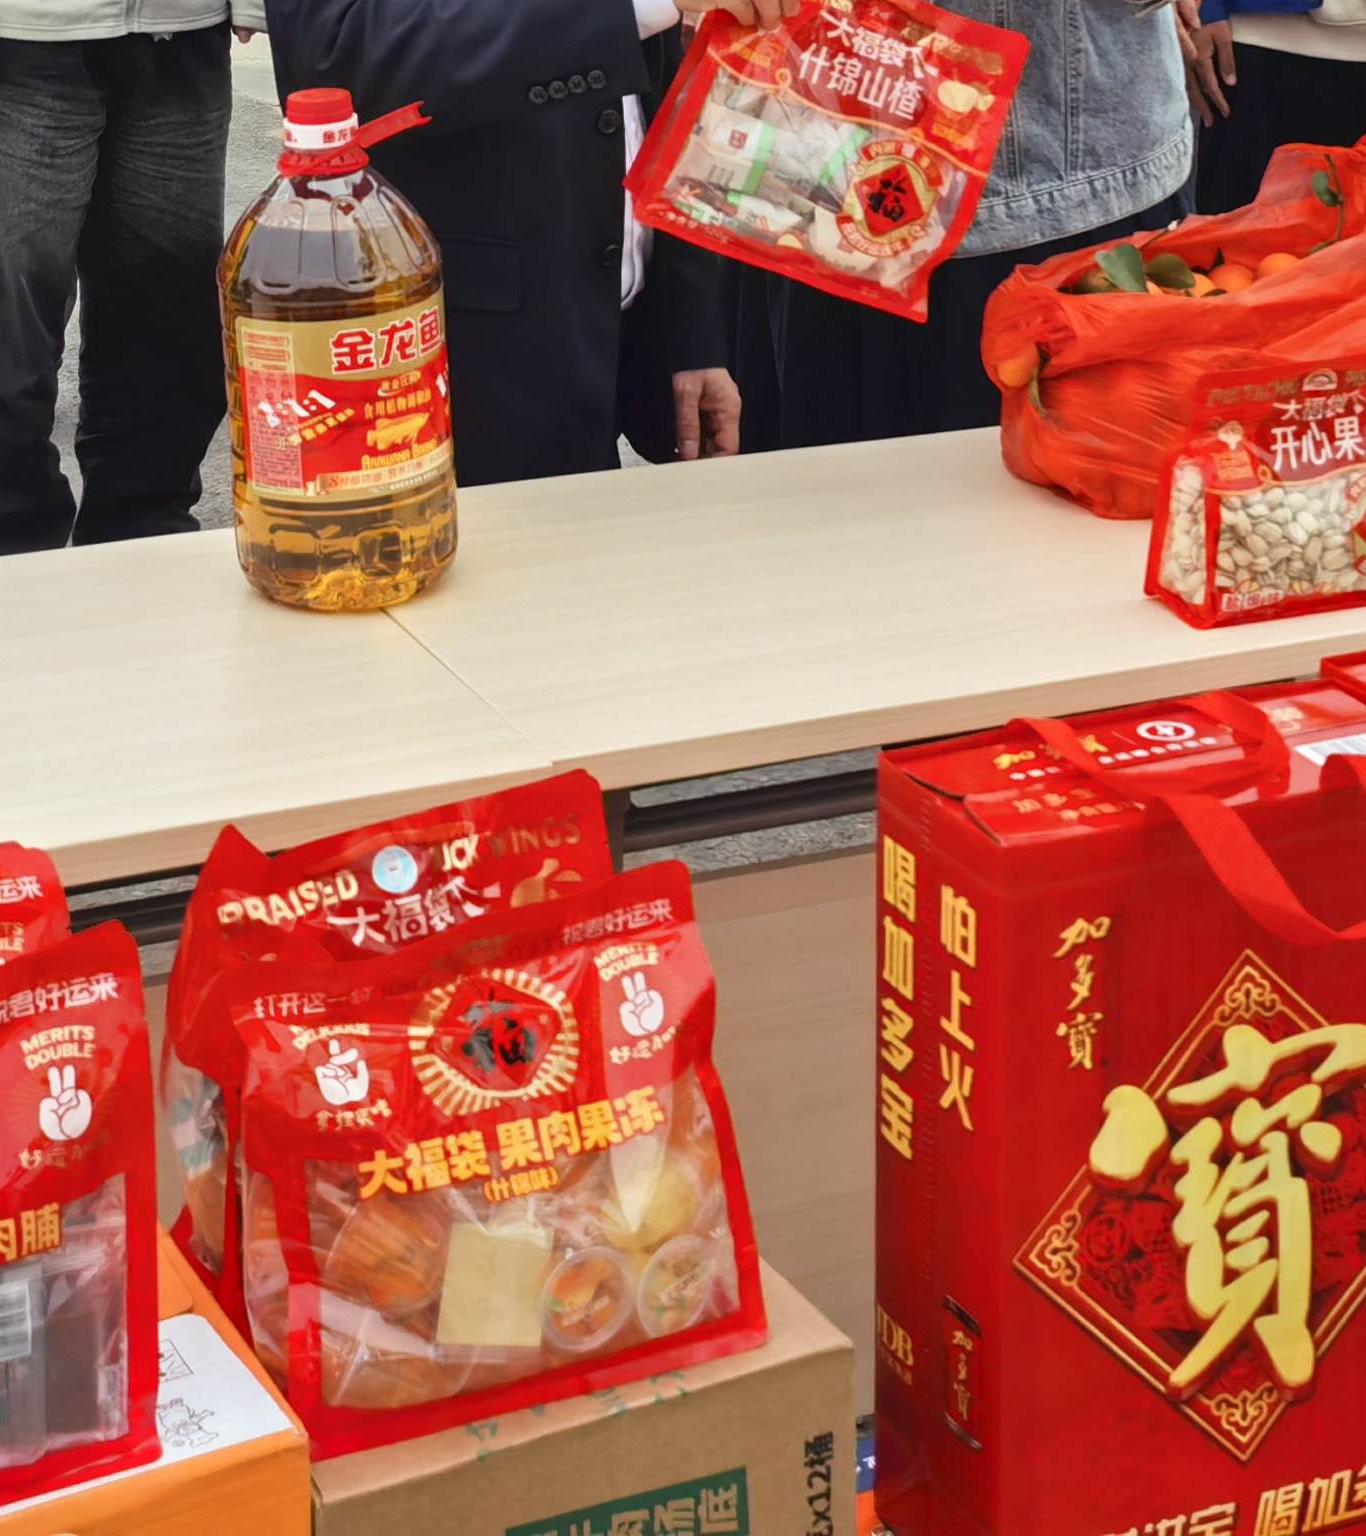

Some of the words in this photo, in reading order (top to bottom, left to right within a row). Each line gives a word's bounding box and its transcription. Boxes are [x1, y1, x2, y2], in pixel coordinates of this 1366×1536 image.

[798, 43, 923, 120] 什锦山楂
[330, 308, 441, 374] 金龙鱼
[1271, 416, 1365, 472] 开心果
[326, 874, 501, 948] 大福袋
[562, 898, 673, 945] 祝君好运来
[599, 951, 659, 982] DOUBLE
[880, 833, 917, 1164] 喝加多宝
[1053, 913, 1111, 1072] 加多寶
[19, 1024, 95, 1054] MERITS
[938, 884, 977, 1134] 怕上火
[24, 1040, 97, 1071] DOUBLE
[358, 1129, 491, 1201] 大福袋
[496, 1086, 665, 1168] 果肉果冻
